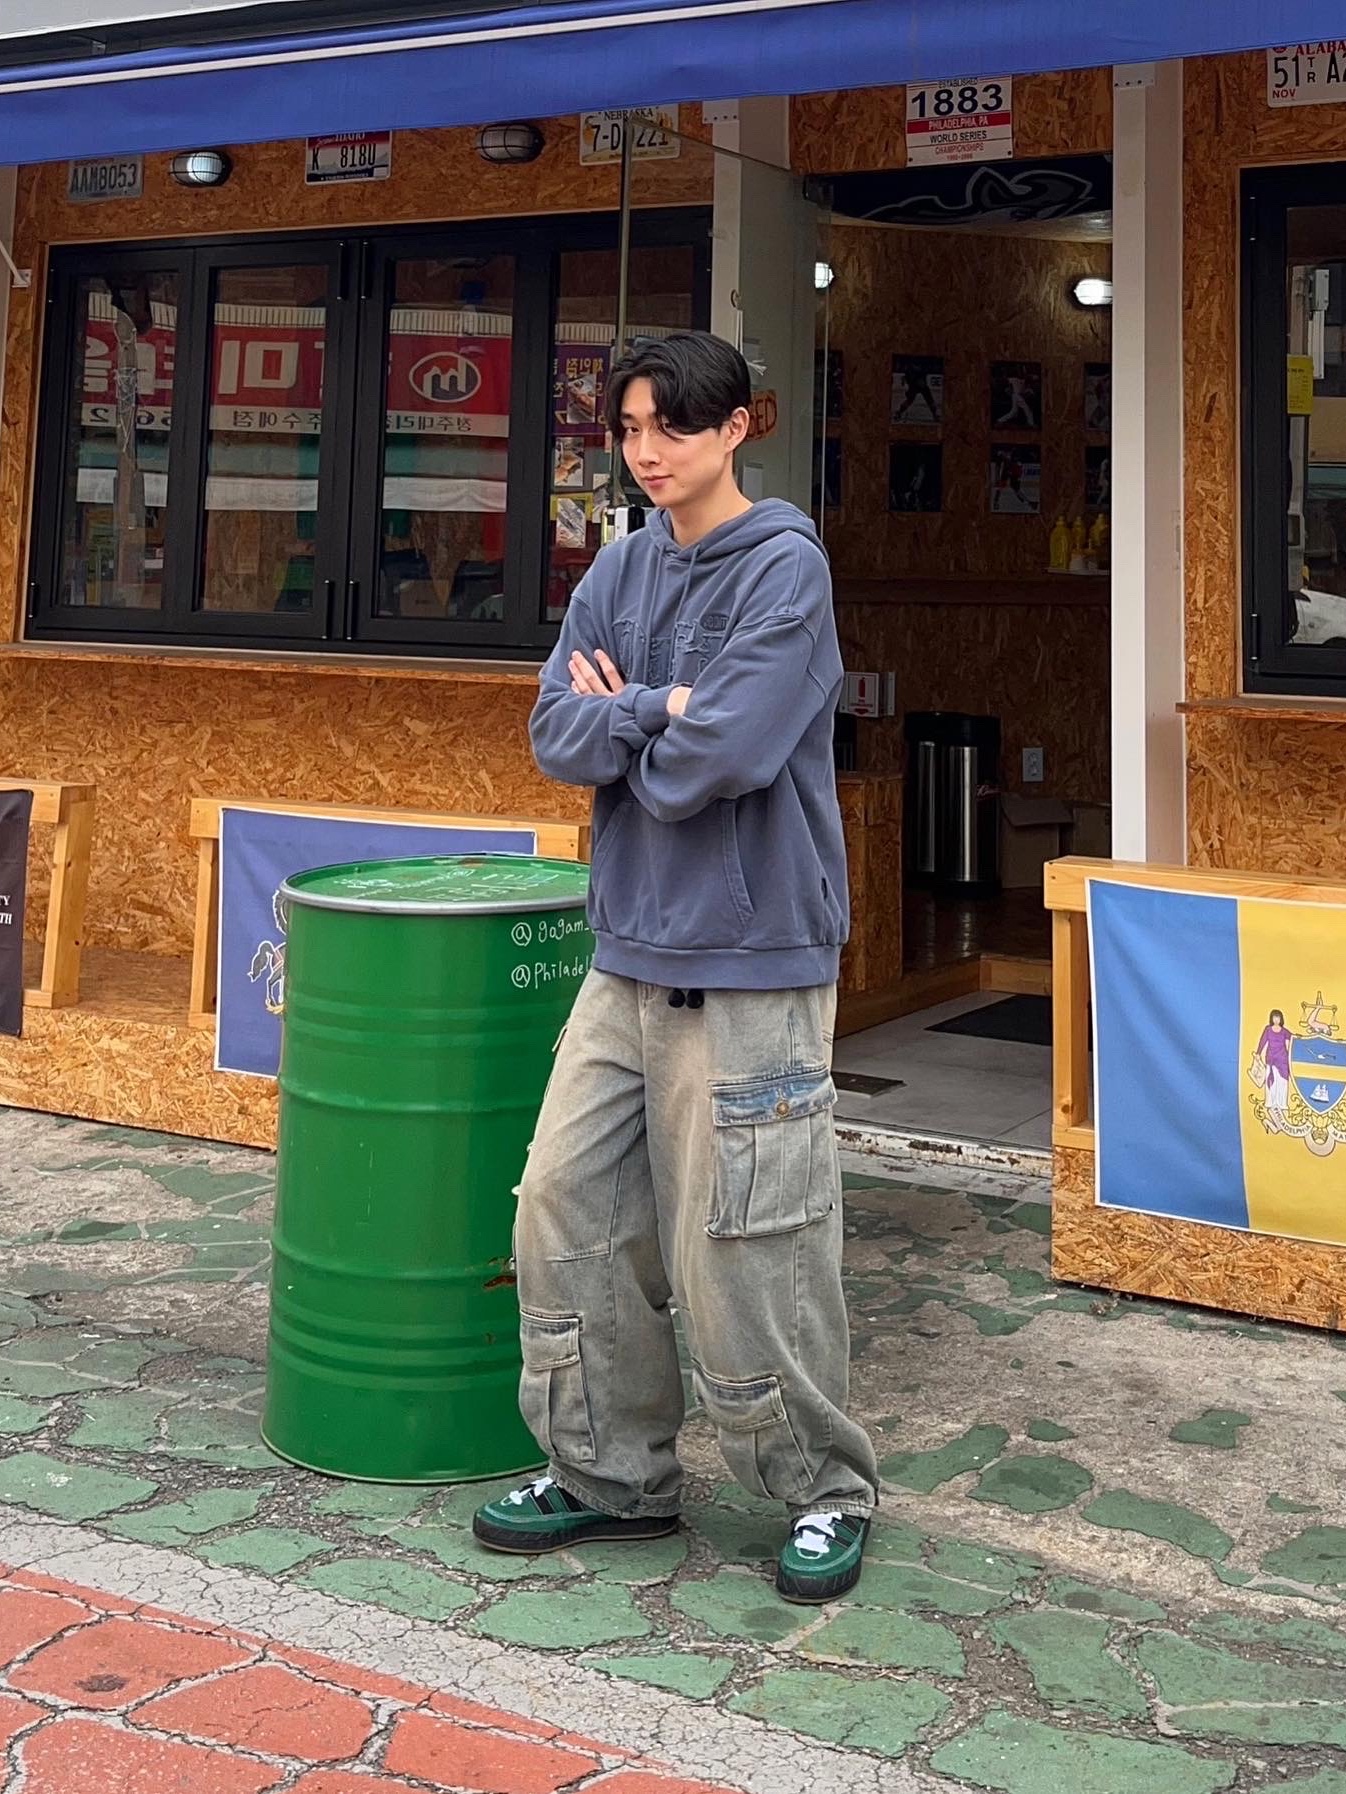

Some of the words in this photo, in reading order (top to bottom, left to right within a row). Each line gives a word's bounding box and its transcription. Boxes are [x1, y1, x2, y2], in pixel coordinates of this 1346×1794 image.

[1273, 54, 1300, 88] 51
[911, 84, 1003, 118] 1883
[1272, 88, 1296, 99] NOV
[978, 115, 989, 126] PA
[930, 133, 958, 144] WORLD
[960, 130, 988, 141] SERIES
[935, 142, 984, 155] CHAMPIONSHIPS
[312, 147, 320, 170] K
[1273, 1107, 1311, 1134] PHILADELPHIA
